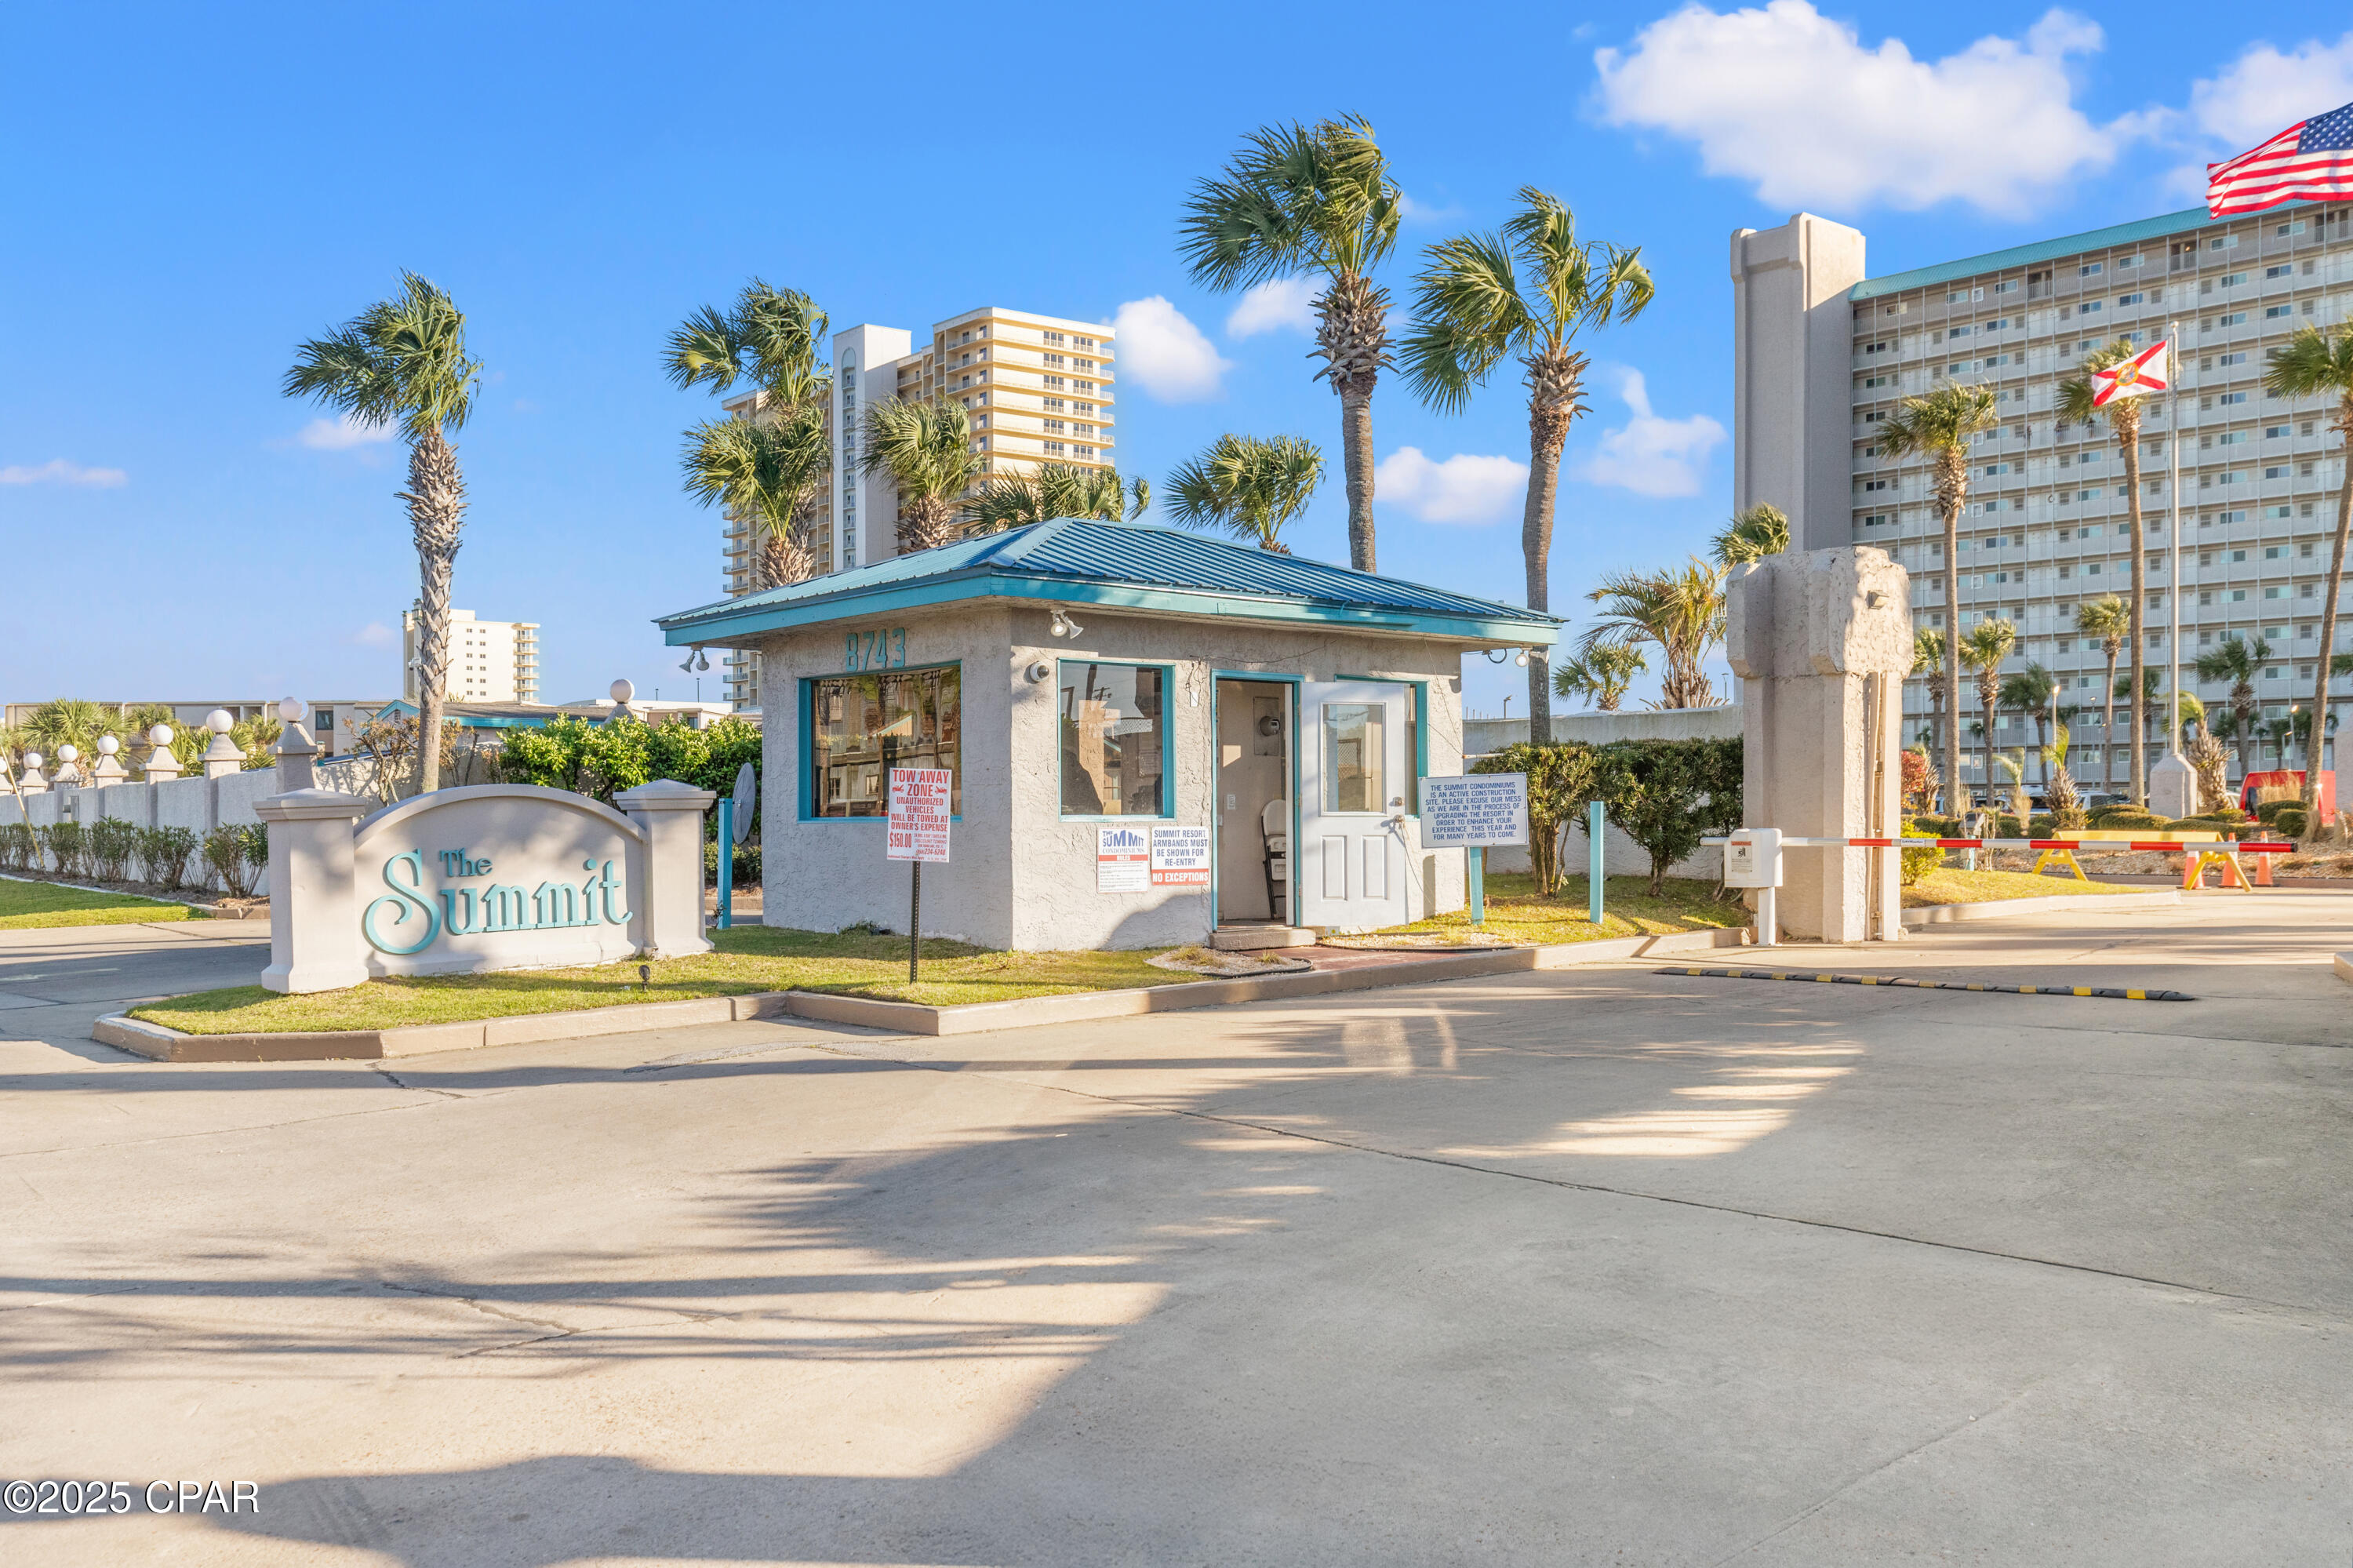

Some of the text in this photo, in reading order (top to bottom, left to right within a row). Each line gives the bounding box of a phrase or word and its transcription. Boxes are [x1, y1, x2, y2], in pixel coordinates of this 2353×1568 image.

[846, 628, 905, 671] 8743
[893, 769, 949, 784] TOW AWAY
[907, 784, 933, 797] ZONE
[897, 797, 943, 806] UNAUTHORIZED
[891, 822, 918, 831] OWNER'S
[889, 831, 911, 851] $150.00
[1103, 830, 1144, 847] SUMMIT
[440, 848, 493, 877] The
[1153, 872, 1208, 882] NO EXCEPTIONS
[363, 848, 633, 955] Summit
